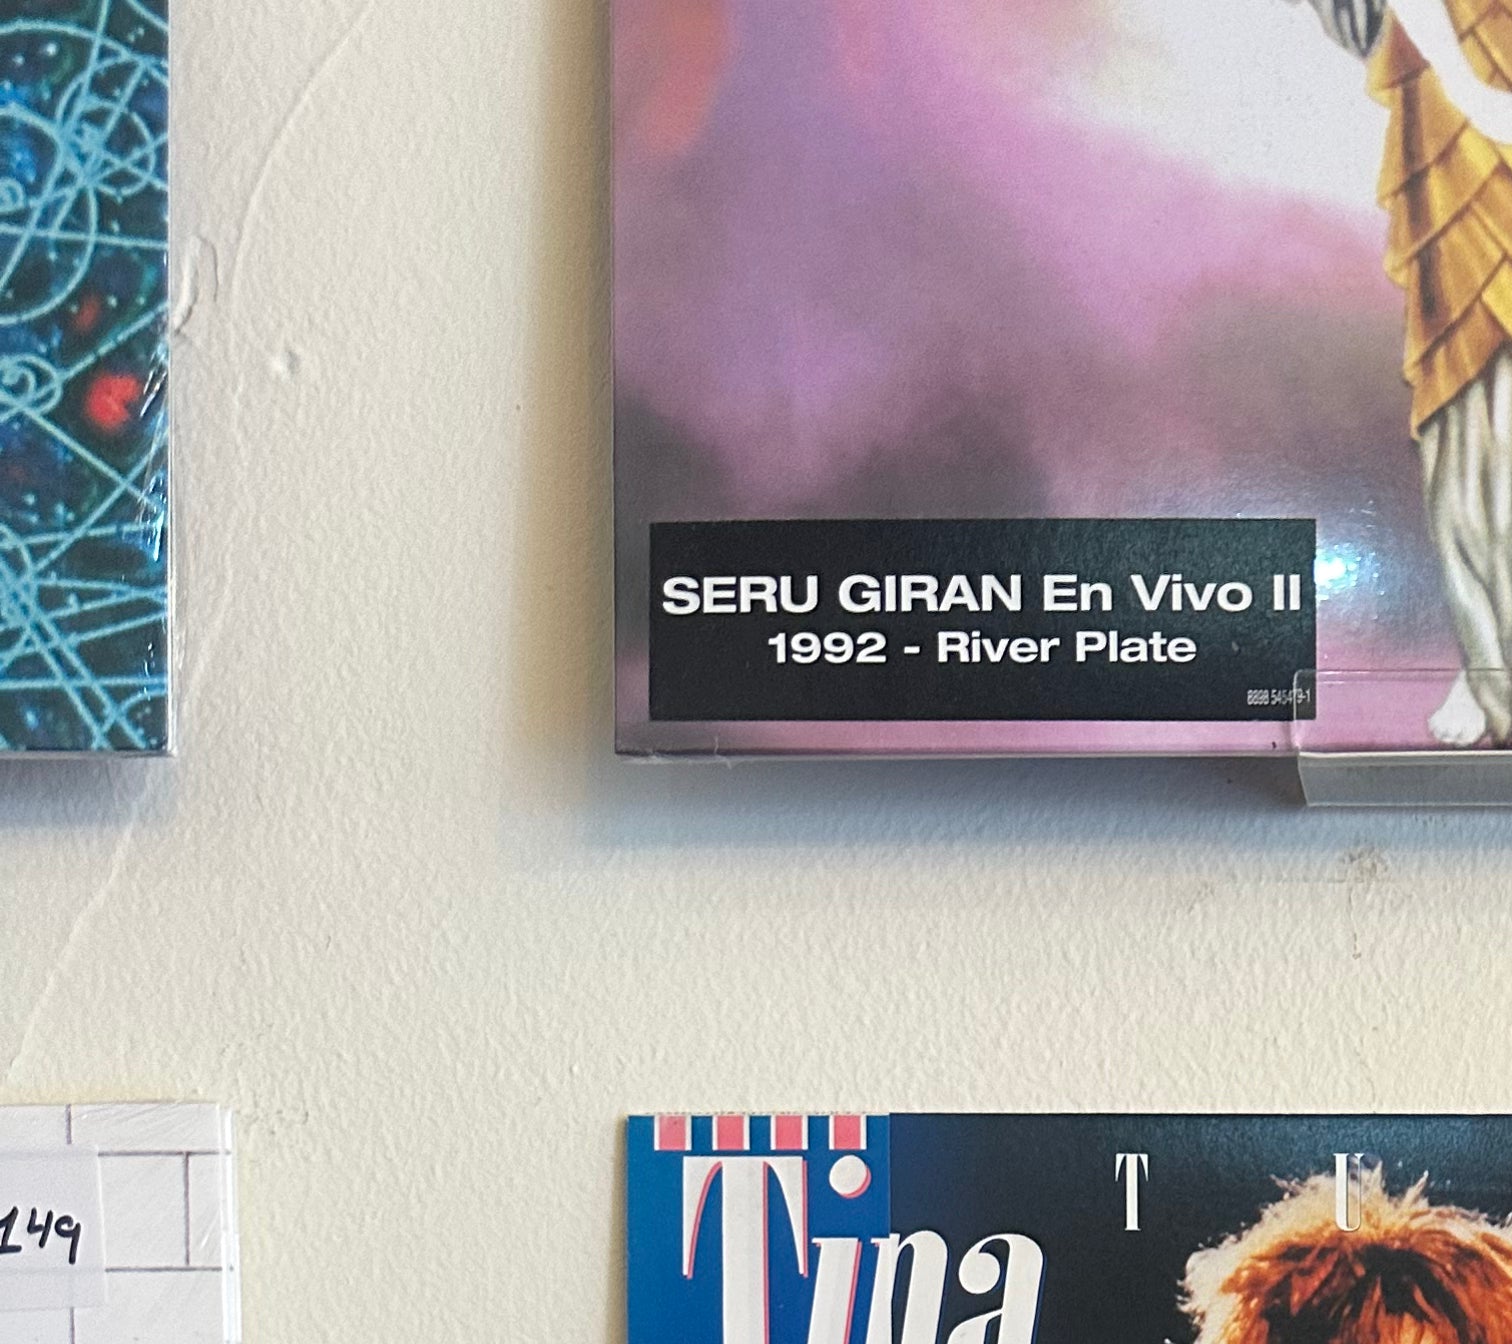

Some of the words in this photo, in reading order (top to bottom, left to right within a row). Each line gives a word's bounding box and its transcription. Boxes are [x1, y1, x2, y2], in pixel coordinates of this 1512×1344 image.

[661, 574, 820, 616] SERU
[838, 573, 1023, 614] GIRAN
[1042, 572, 1113, 613] En
[1129, 572, 1253, 613] Vivo
[1271, 572, 1303, 613] II
[767, 631, 889, 666] 1992
[902, 646, 921, 656] -
[937, 630, 1061, 665] River
[1075, 630, 1198, 664] Plate
